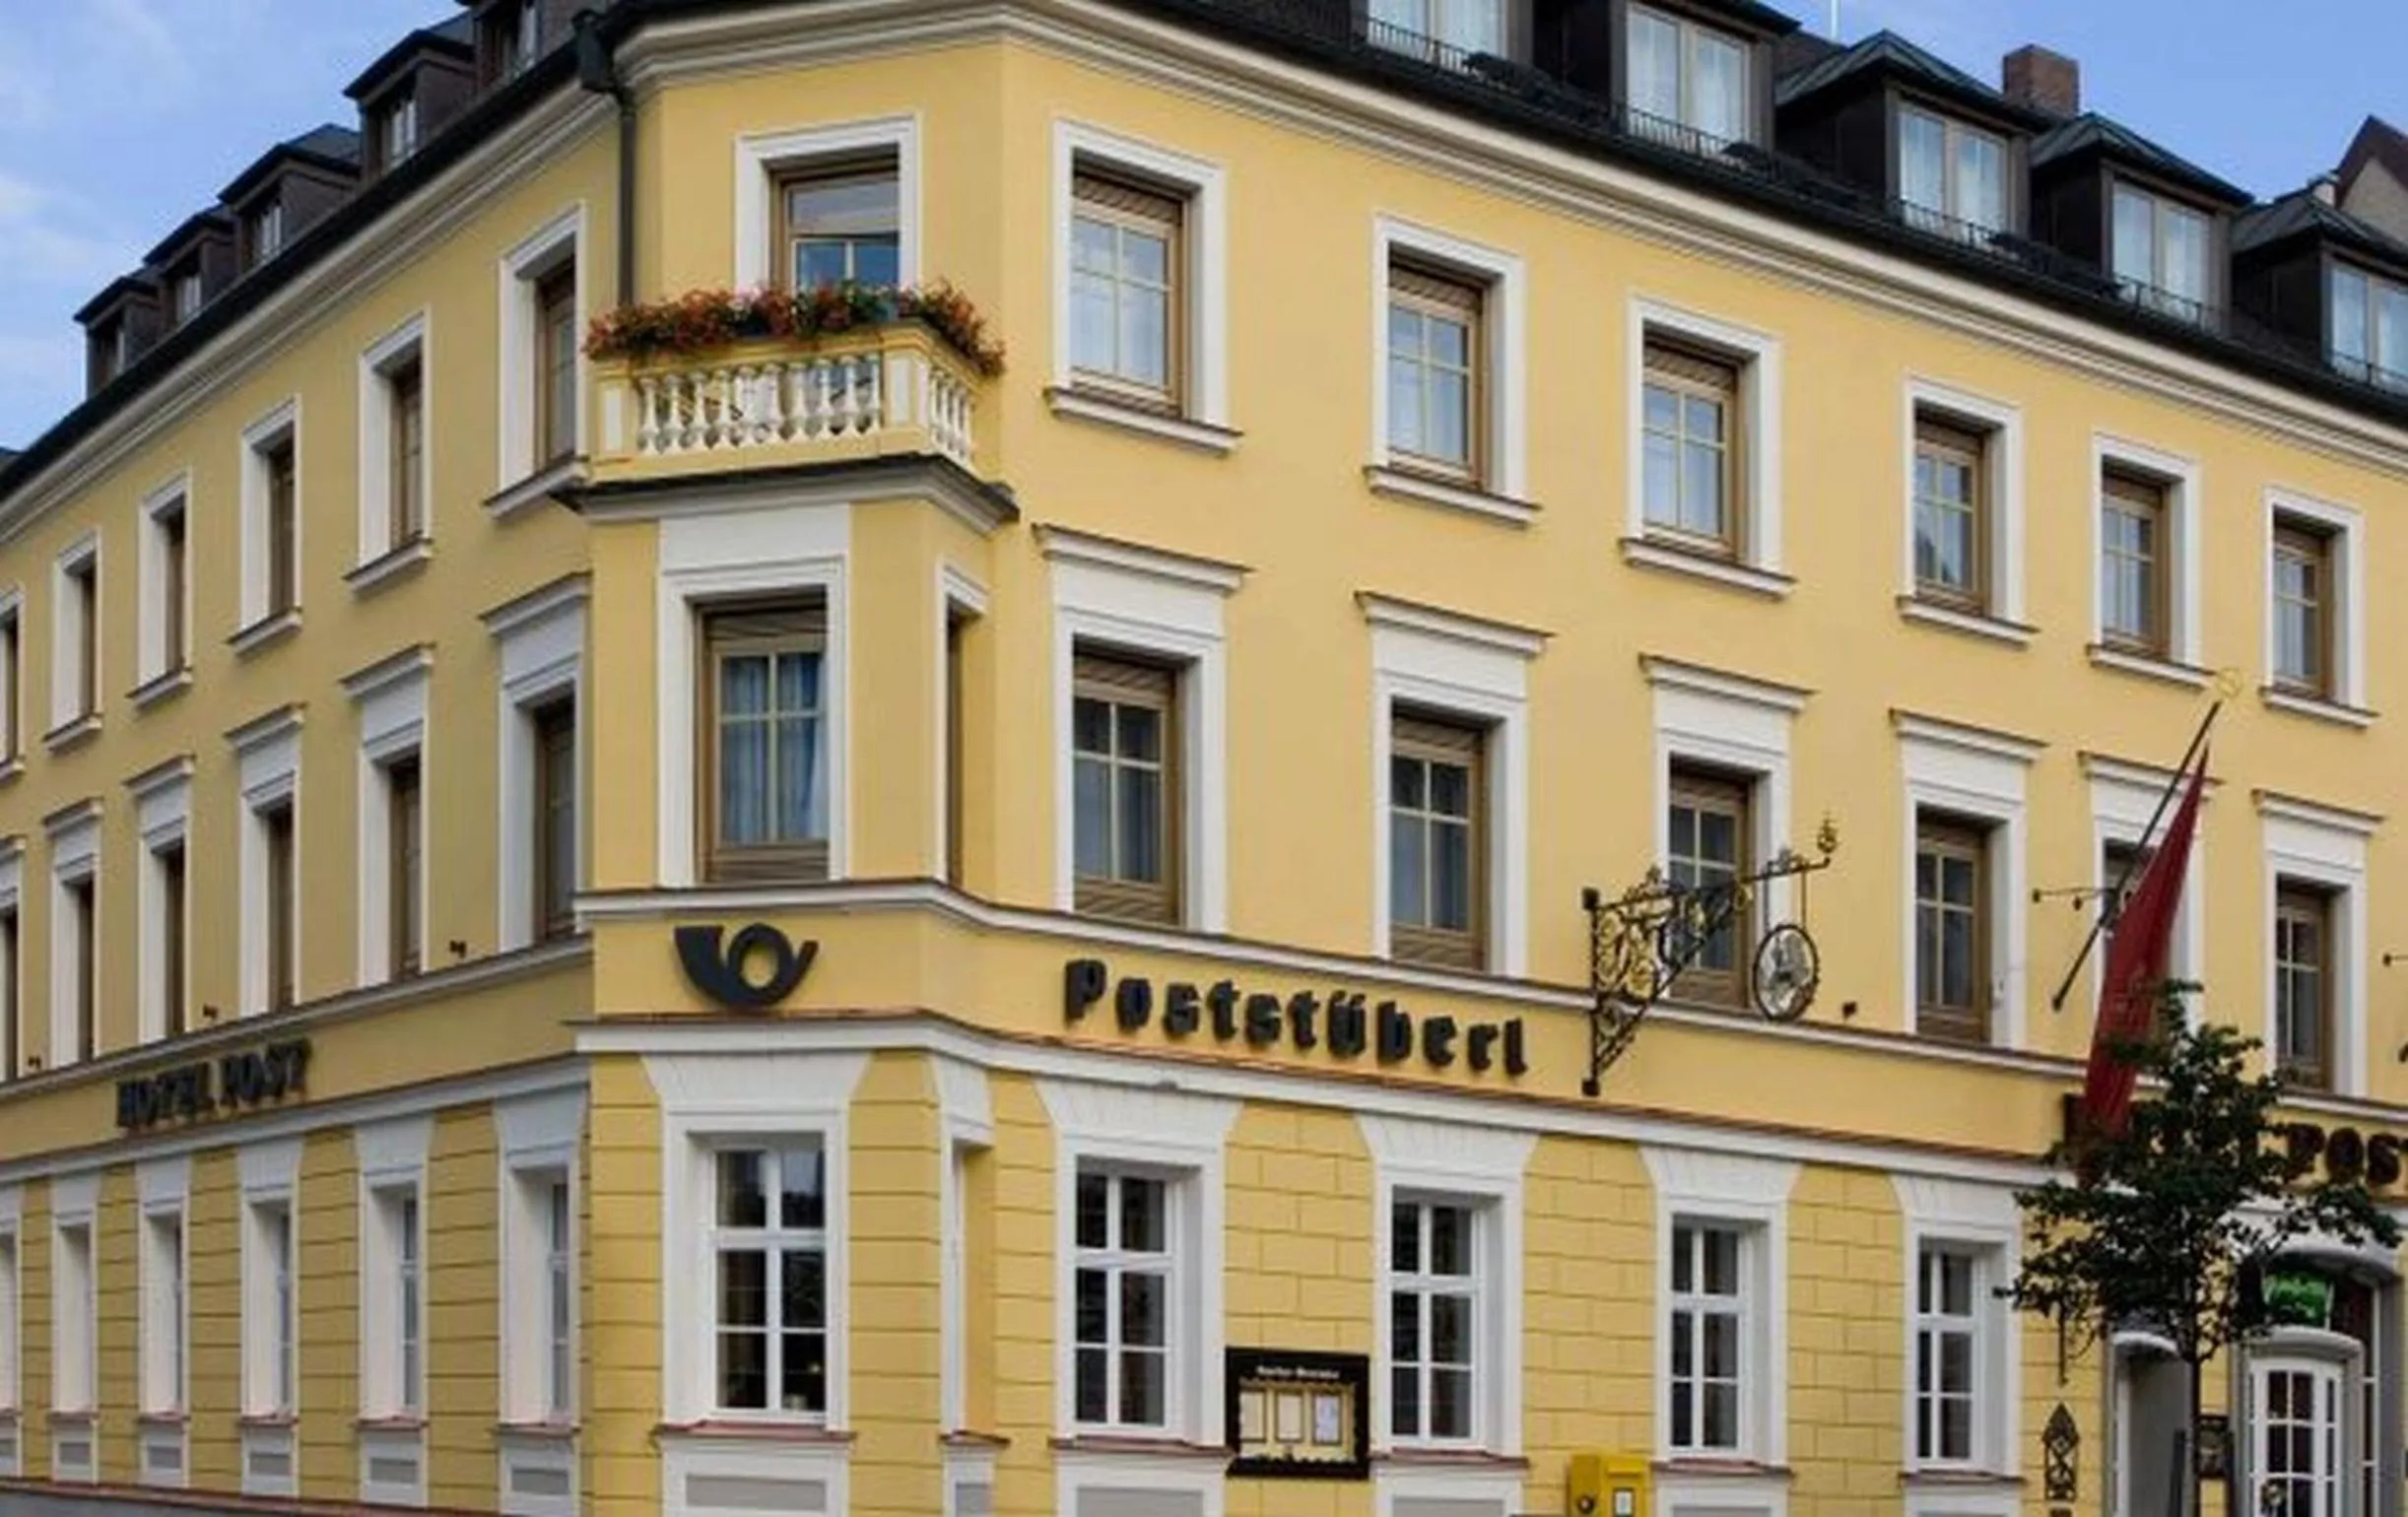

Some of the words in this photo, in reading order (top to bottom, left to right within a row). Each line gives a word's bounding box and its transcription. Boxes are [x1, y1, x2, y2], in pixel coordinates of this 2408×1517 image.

[1064, 958, 1527, 1075] Poststüberl
[116, 1060, 215, 1128] HOTEL
[221, 1038, 311, 1107] POST
[2286, 1123, 2408, 1186] POS
